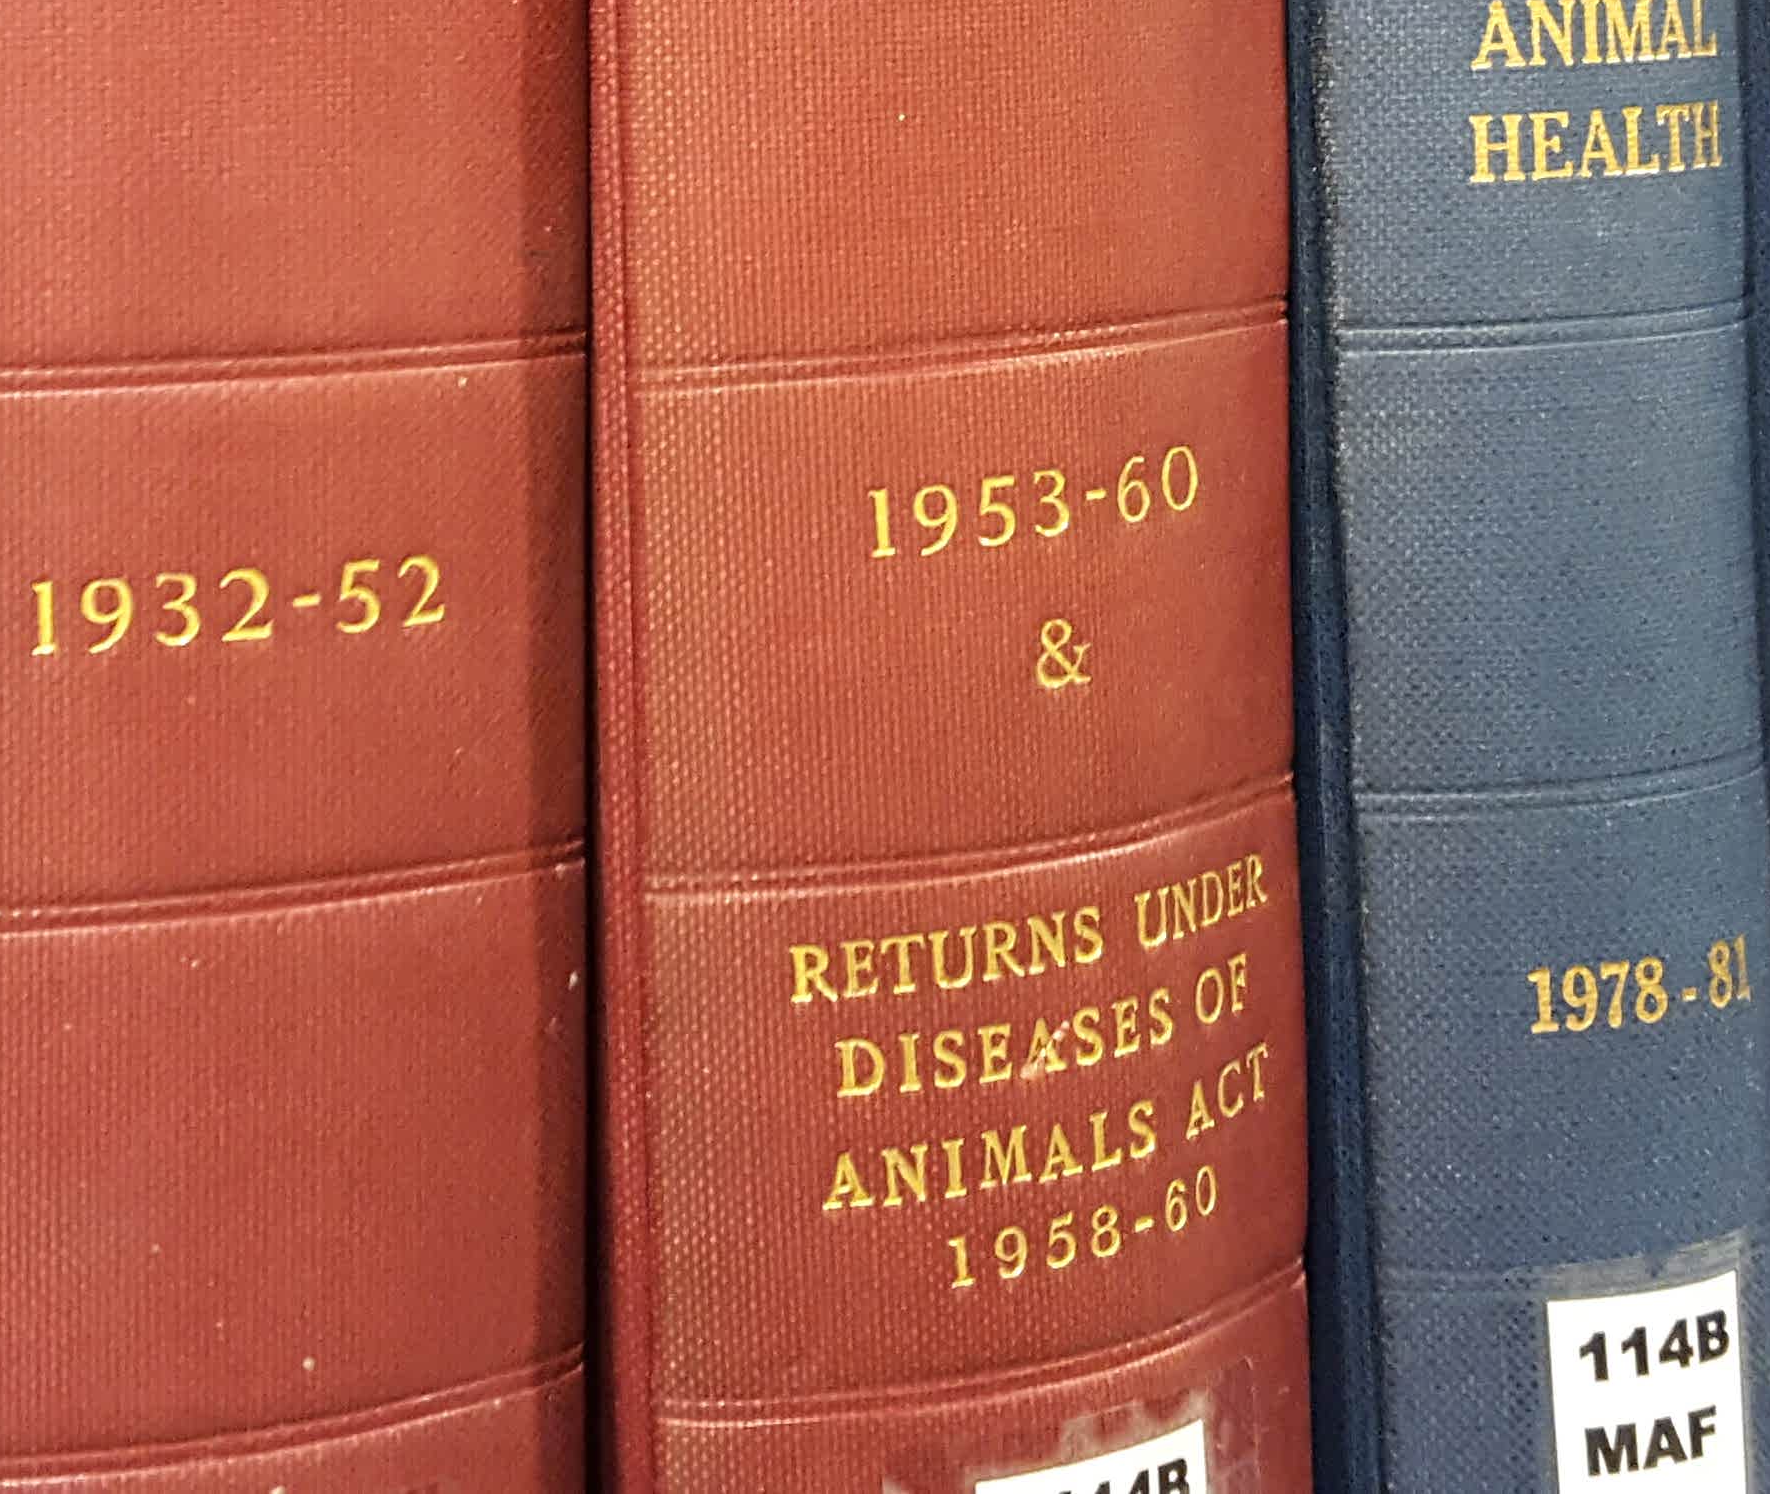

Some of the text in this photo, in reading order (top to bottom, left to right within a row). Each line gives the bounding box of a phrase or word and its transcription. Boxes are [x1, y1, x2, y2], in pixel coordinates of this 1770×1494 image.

[1467, 98, 1724, 185] HEALTH
[867, 444, 1199, 559] 1953-60
[30, 553, 447, 657] 1932-52
[1035, 617, 1093, 691] &
[788, 852, 1269, 1006] RETURNS UNDER
[833, 952, 1249, 1101] DISEASES OF
[821, 1041, 1271, 1212] ANIMALS ACT
[950, 1164, 1220, 1290] 1958-60
[1578, 1308, 1731, 1383] 114B
[1583, 1404, 1718, 1478] MAF
